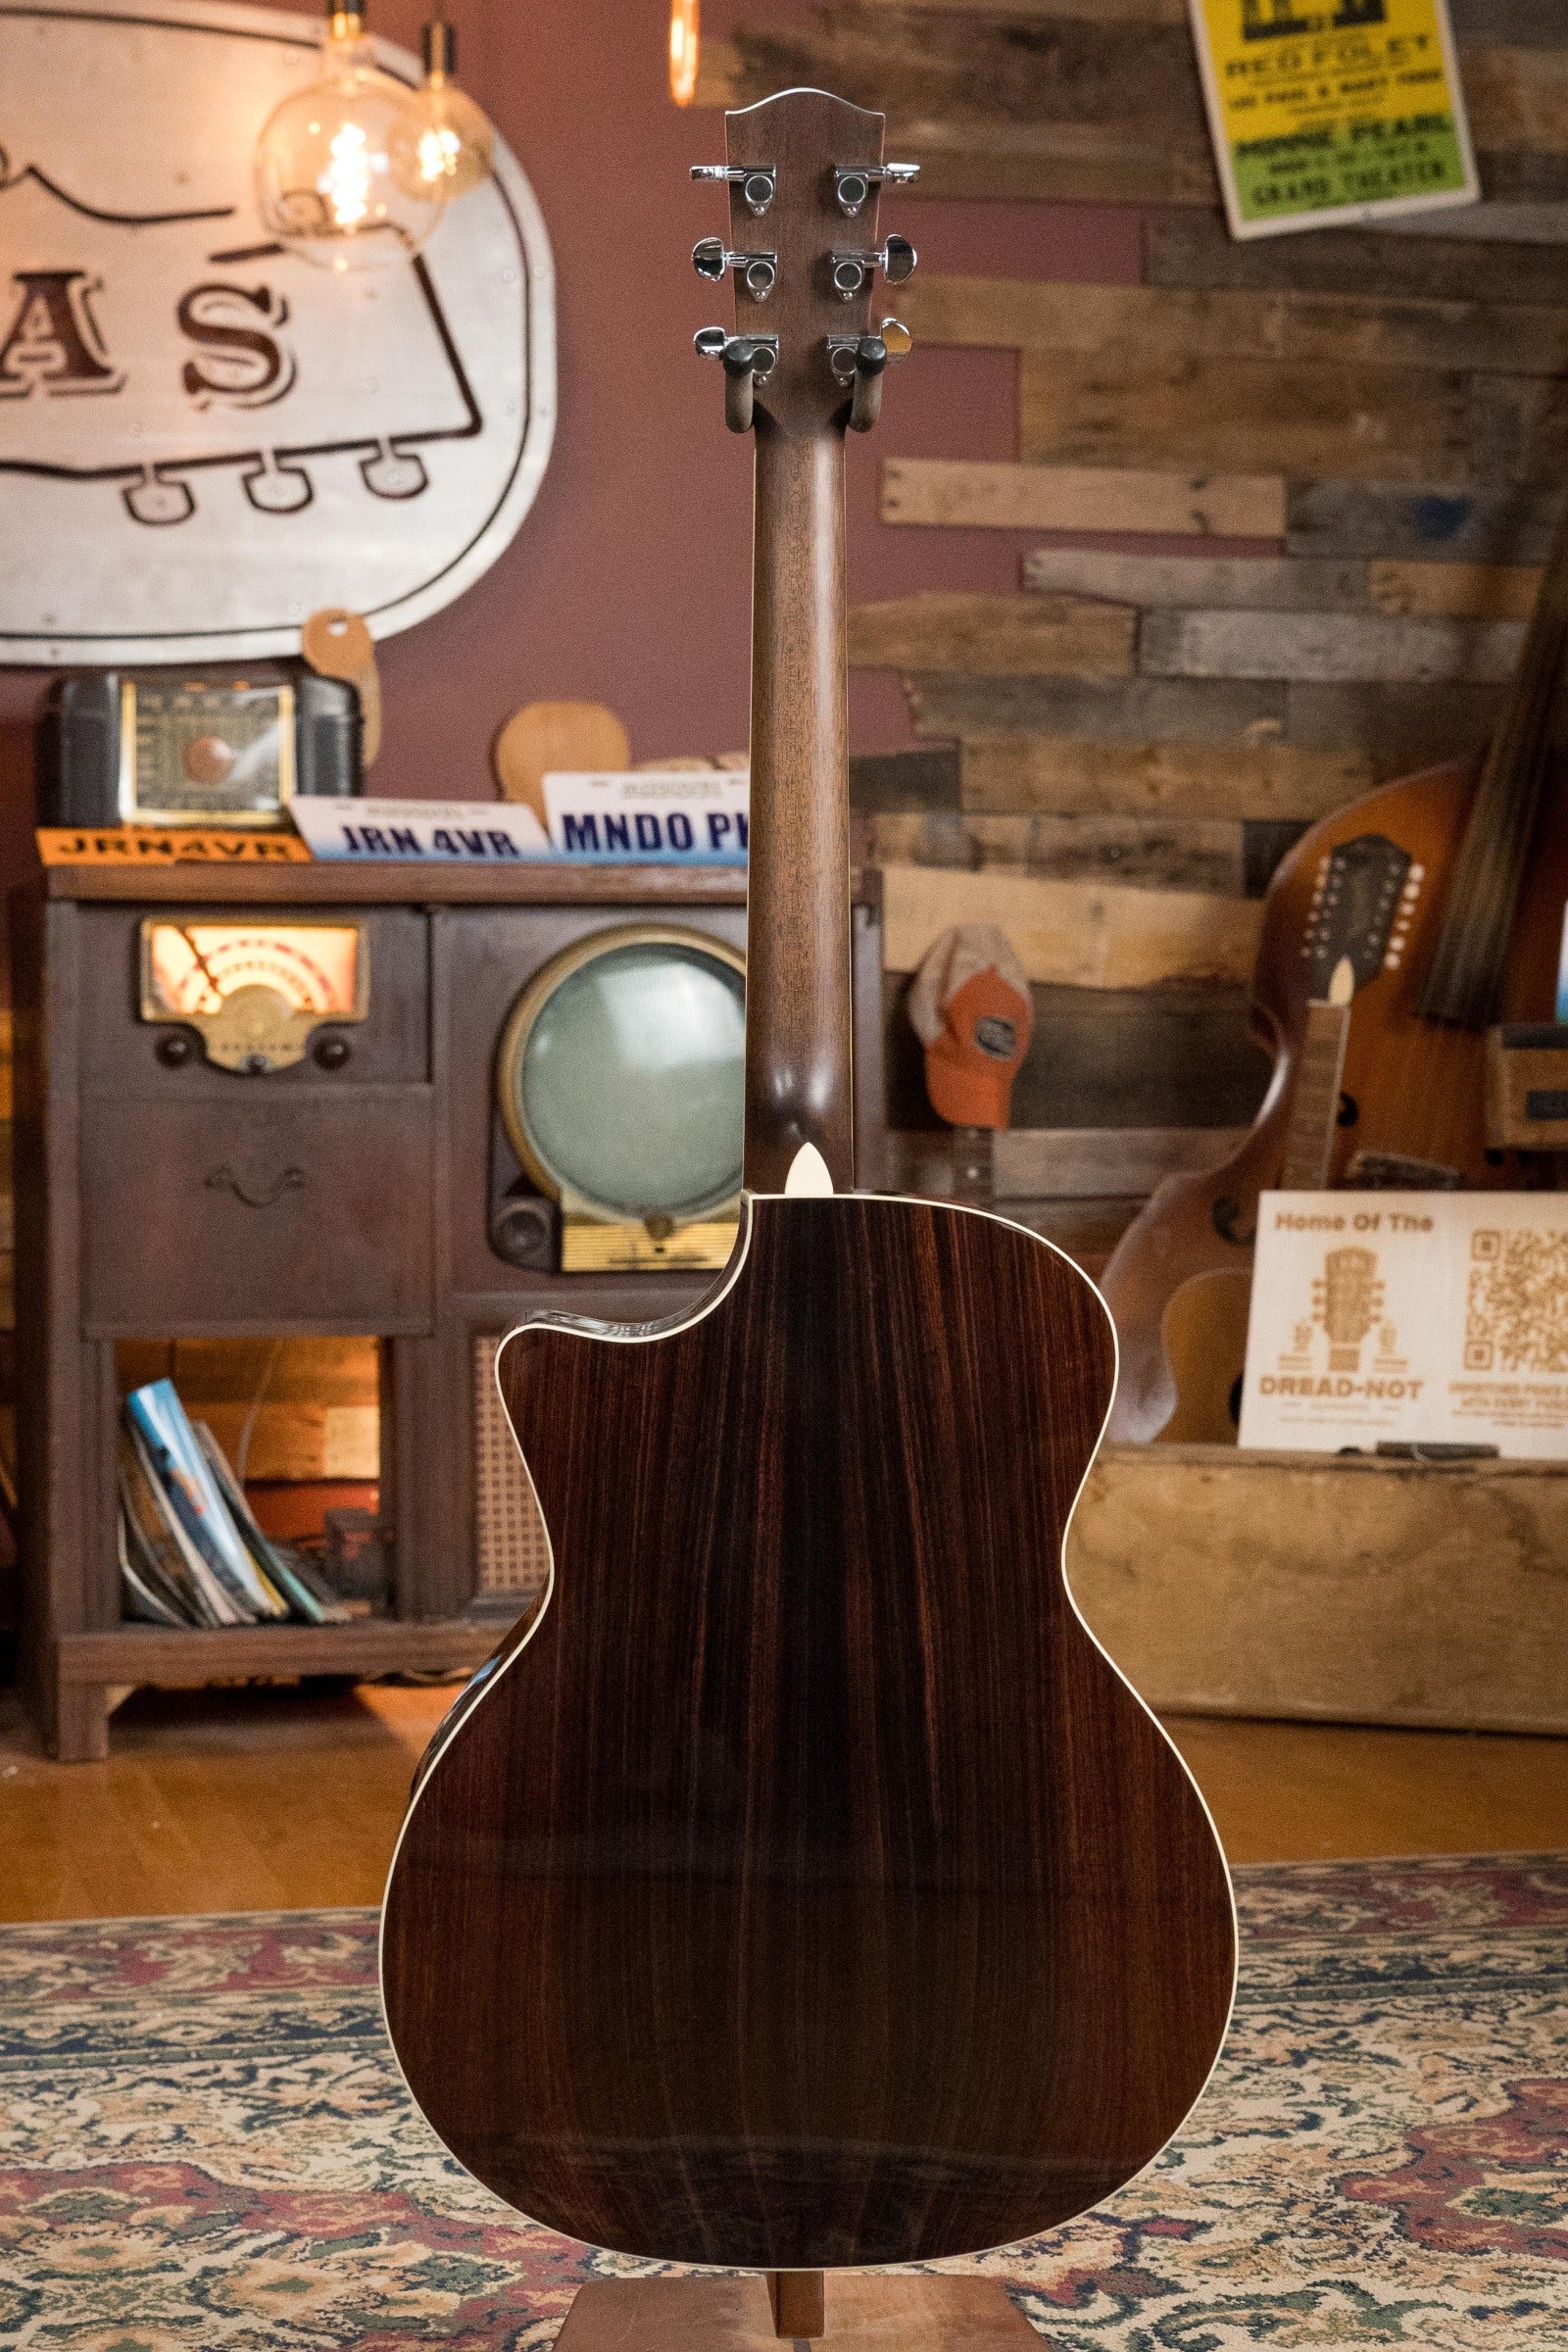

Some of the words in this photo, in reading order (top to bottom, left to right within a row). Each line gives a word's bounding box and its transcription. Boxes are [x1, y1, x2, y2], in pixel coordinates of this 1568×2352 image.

[562, 812, 695, 852] MNDO
[1275, 1212, 1346, 1232] Home
[1353, 1212, 1382, 1232] Of
[1390, 1212, 1435, 1233] The
[1259, 1376, 1425, 1399] DREAD-NOT
